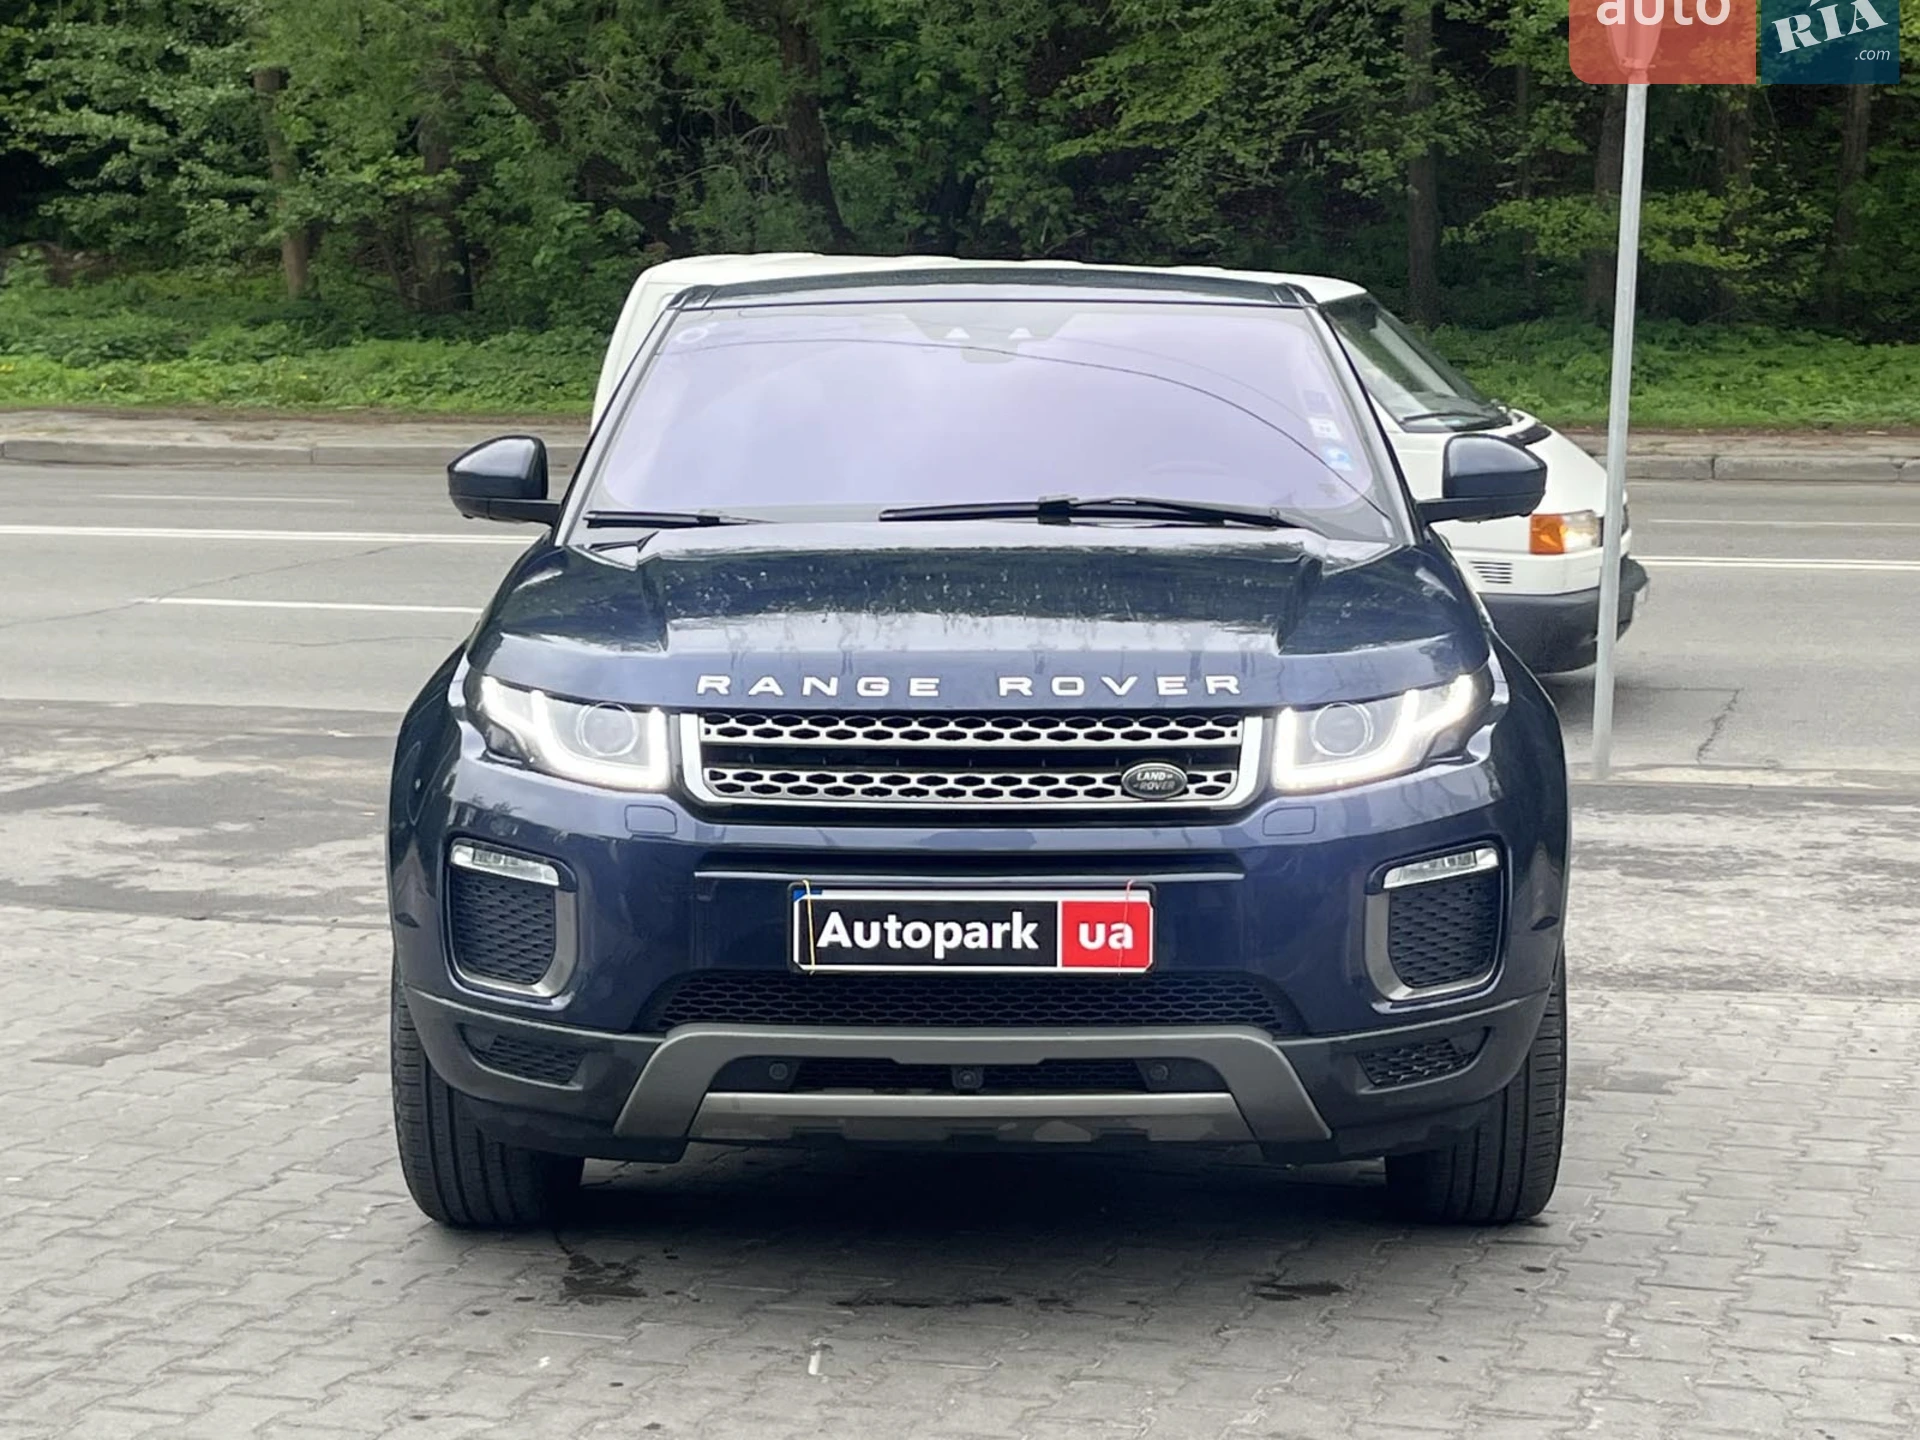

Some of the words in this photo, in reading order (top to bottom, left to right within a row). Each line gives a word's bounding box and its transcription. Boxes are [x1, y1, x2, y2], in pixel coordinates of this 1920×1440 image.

[697, 675, 940, 697] RANGE
[999, 674, 1241, 696] ROVER
[1140, 781, 1175, 790] ROVER
[816, 911, 1039, 959] Autopark
[1079, 922, 1133, 949] ua
